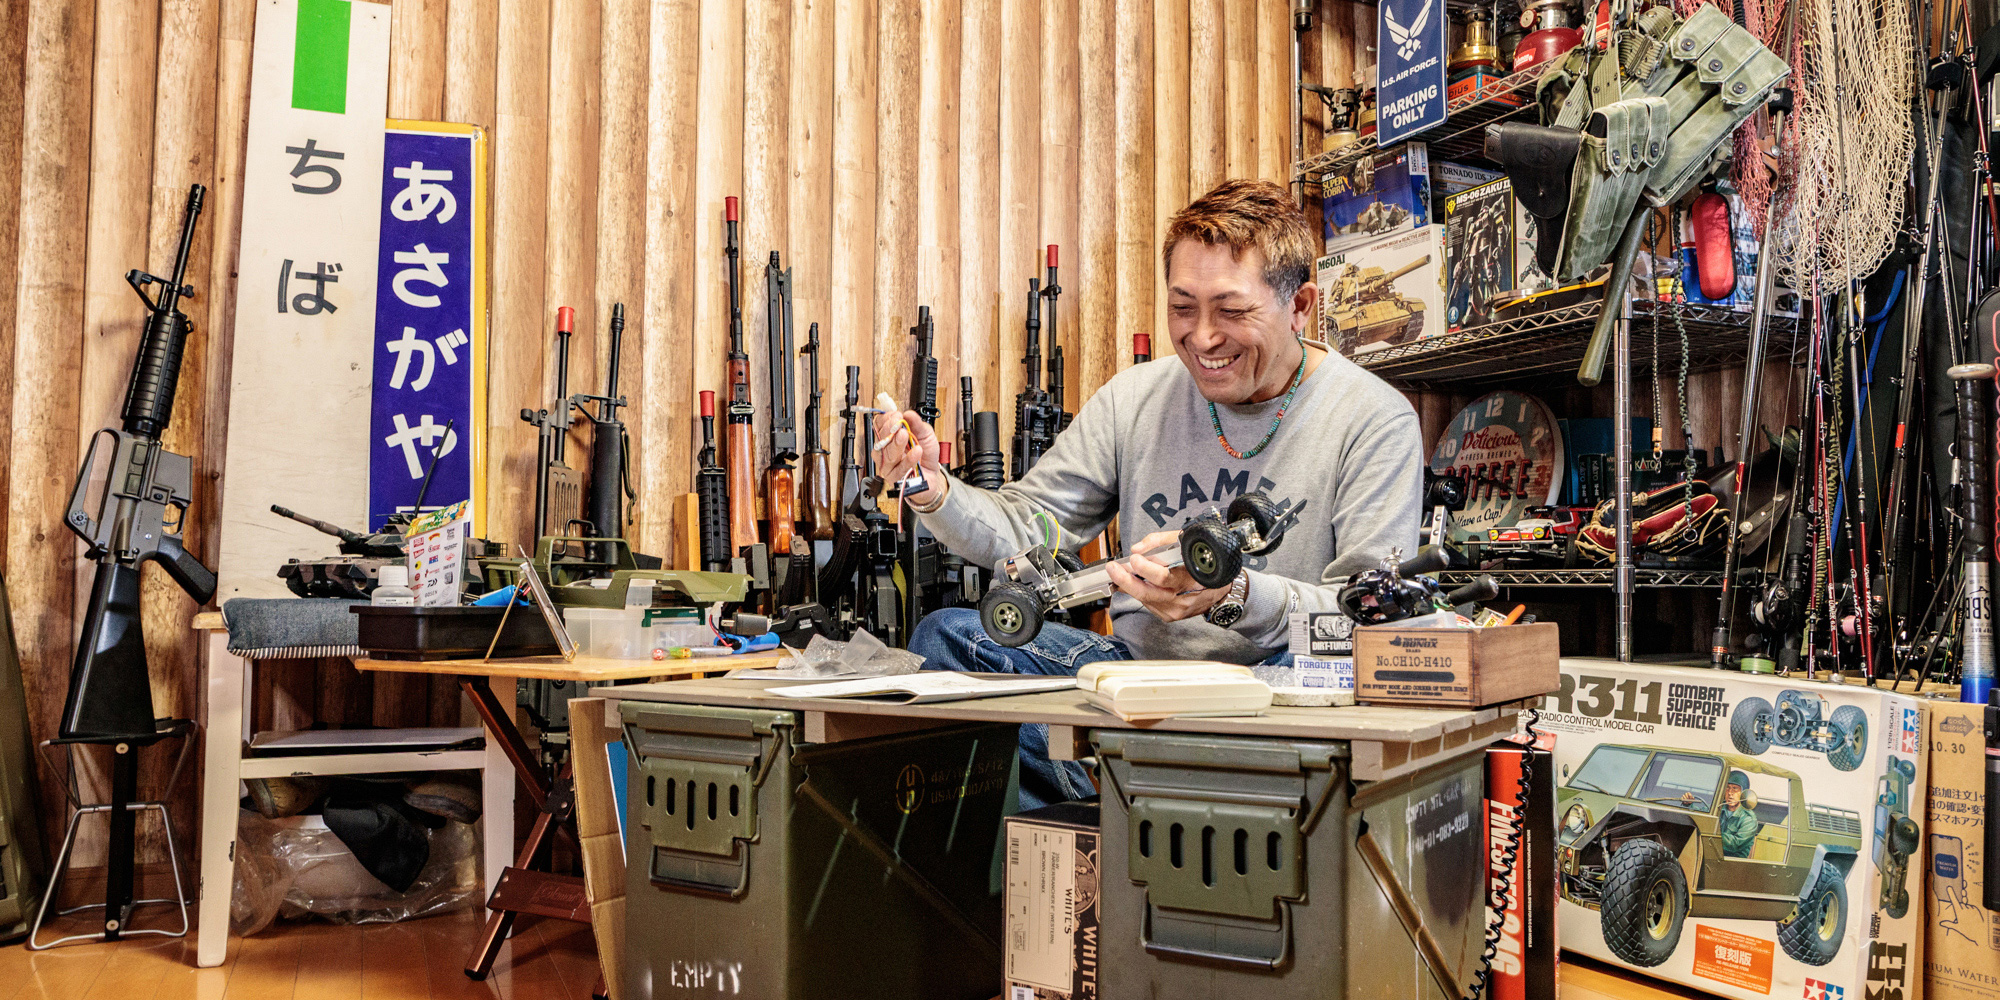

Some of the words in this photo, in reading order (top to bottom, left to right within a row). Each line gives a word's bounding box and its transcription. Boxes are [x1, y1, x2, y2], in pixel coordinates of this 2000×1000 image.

[1396, 69, 1409, 82] AIR
[1449, 84, 1469, 98] DIUS
[1382, 85, 1438, 119] PARKING
[1393, 104, 1427, 129] ONLY
[1439, 166, 1474, 179] TORNADO
[1322, 175, 1343, 191] SUPER
[1323, 185, 1346, 199] COBRA
[1480, 183, 1503, 198] ZAKU
[278, 139, 344, 315] ちば
[385, 161, 468, 480] あさがや
[1485, 397, 1505, 417] 12
[1463, 410, 1477, 431] 11
[1462, 426, 1521, 450] Delicious
[1530, 426, 1545, 448] 2
[1439, 438, 1457, 459] 10
[1465, 452, 1484, 461] FRESH
[1487, 450, 1512, 459] BREWED
[1635, 458, 1658, 471] KATO
[1141, 468, 1299, 528] RAME
[1484, 503, 1504, 524] Cup!
[1312, 641, 1353, 651] DIRT-TUNED
[1298, 661, 1332, 670] TORQUE
[1333, 662, 1354, 670] TUN
[1668, 683, 1725, 702] COMBAT
[1666, 698, 1730, 717] SUPPORT
[1538, 712, 1562, 723] RADIO
[1563, 715, 1603, 728] CONTROL
[1603, 719, 1634, 732] MODEL
[1635, 724, 1655, 734] CAR
[1666, 712, 1716, 731] VEHICLE
[1064, 888, 1073, 935] WHITE'S
[1082, 926, 1097, 1000] WHITE'
[1714, 944, 1752, 967] 復刻版
[1958, 968, 1999, 986] WATER
